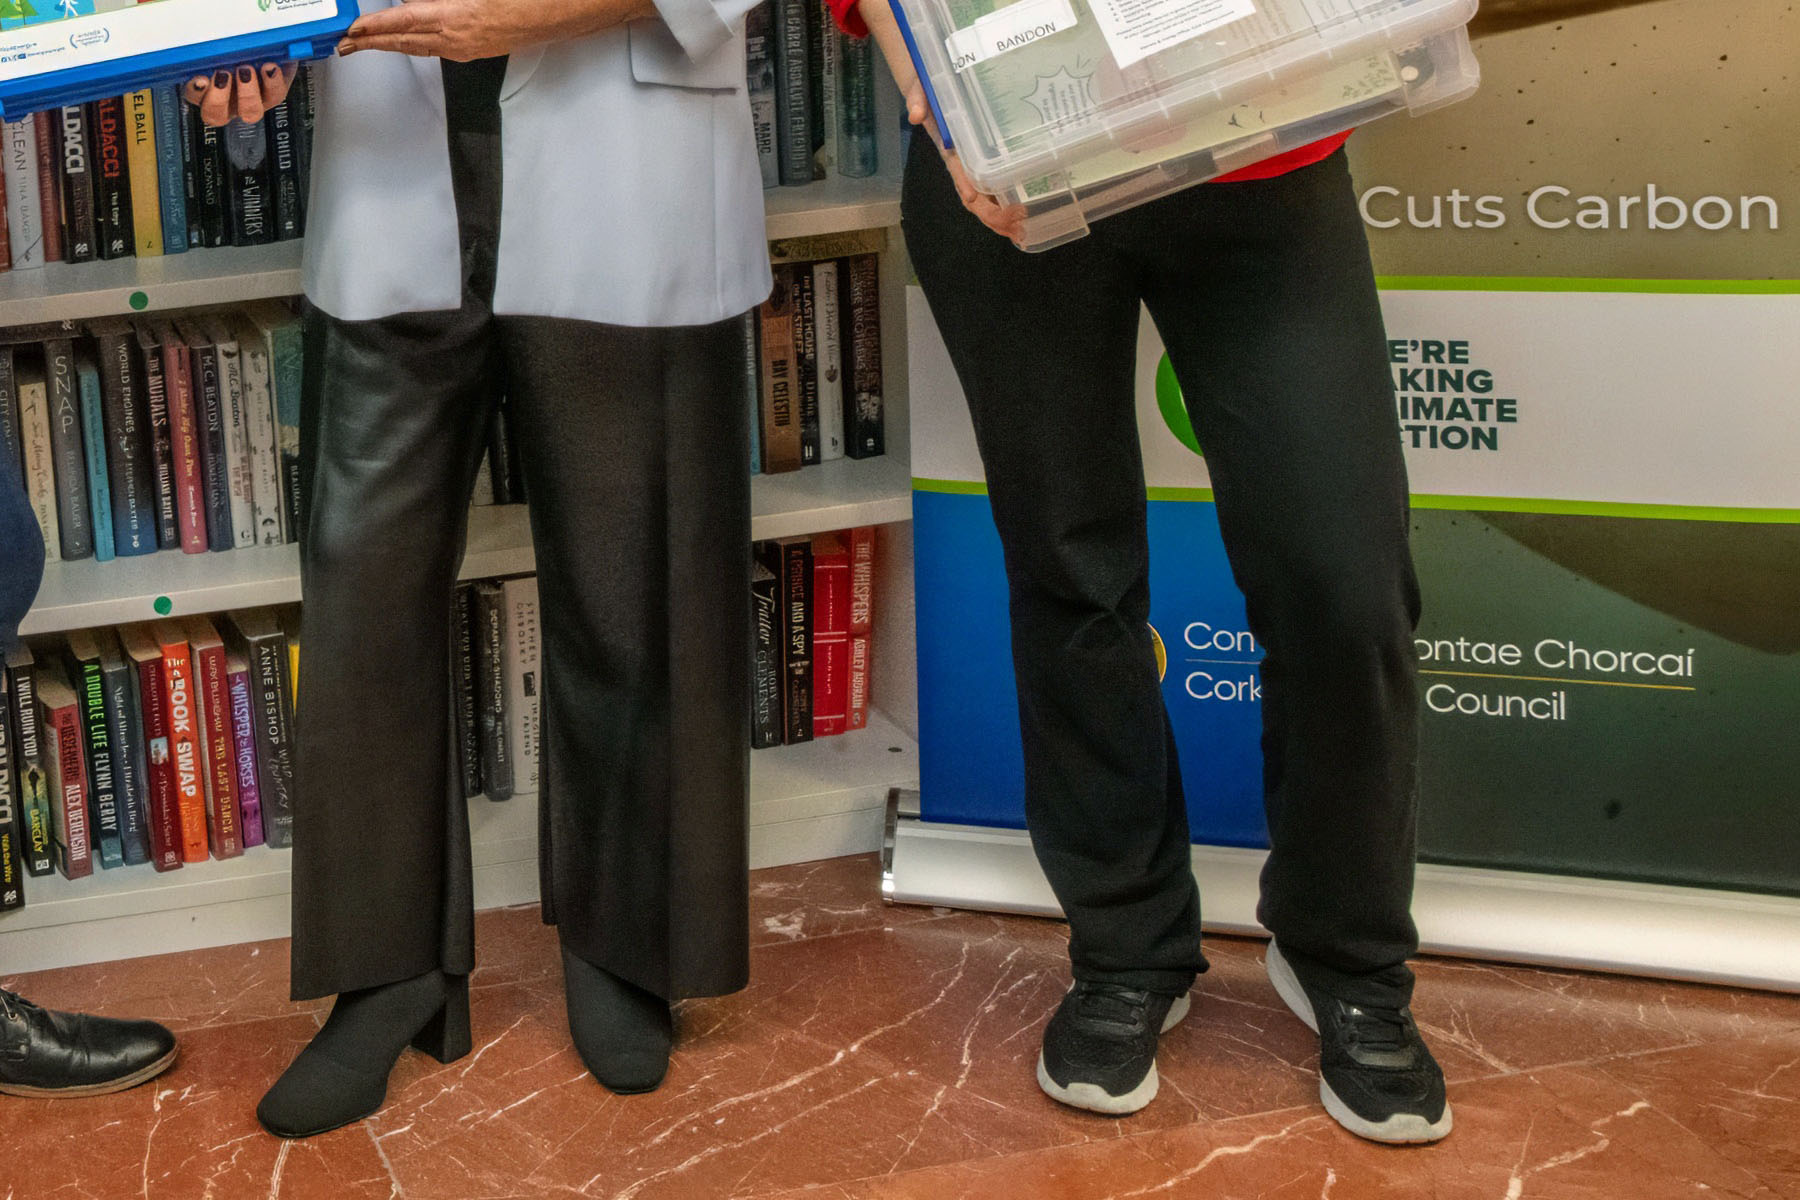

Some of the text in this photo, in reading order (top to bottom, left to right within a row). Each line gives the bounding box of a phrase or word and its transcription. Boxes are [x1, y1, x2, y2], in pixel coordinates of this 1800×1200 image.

[996, 21, 1056, 53] BANDON
[135, 113, 148, 144] BALL
[279, 134, 291, 169] CHILD
[244, 186, 264, 236] WINNERS
[1358, 183, 1779, 231] Cuts Carbon
[1390, 339, 1470, 366] E'RE
[55, 356, 73, 433] SNAP
[117, 343, 135, 433] WORLD ENGINES
[150, 373, 166, 426] MURALS
[1395, 369, 1494, 395] KING
[207, 387, 218, 432] BEATON
[1400, 398, 1517, 424] IMATE
[753, 587, 775, 644] Traitor
[852, 561, 870, 624] WHISPERS
[792, 634, 805, 655] SPY
[1414, 636, 1521, 668] ontae
[1535, 637, 1695, 679] Chorcaí
[260, 646, 279, 745] ANNE BISHOP
[757, 648, 769, 724] CLEMENTS
[1185, 671, 1566, 721] Cork Council
[86, 676, 116, 831] DOUBLE LIFE FLYNN BERRY
[172, 680, 195, 796] BOOK SWAP
[18, 682, 43, 853] WILL RUIN YOU BARCLAY
